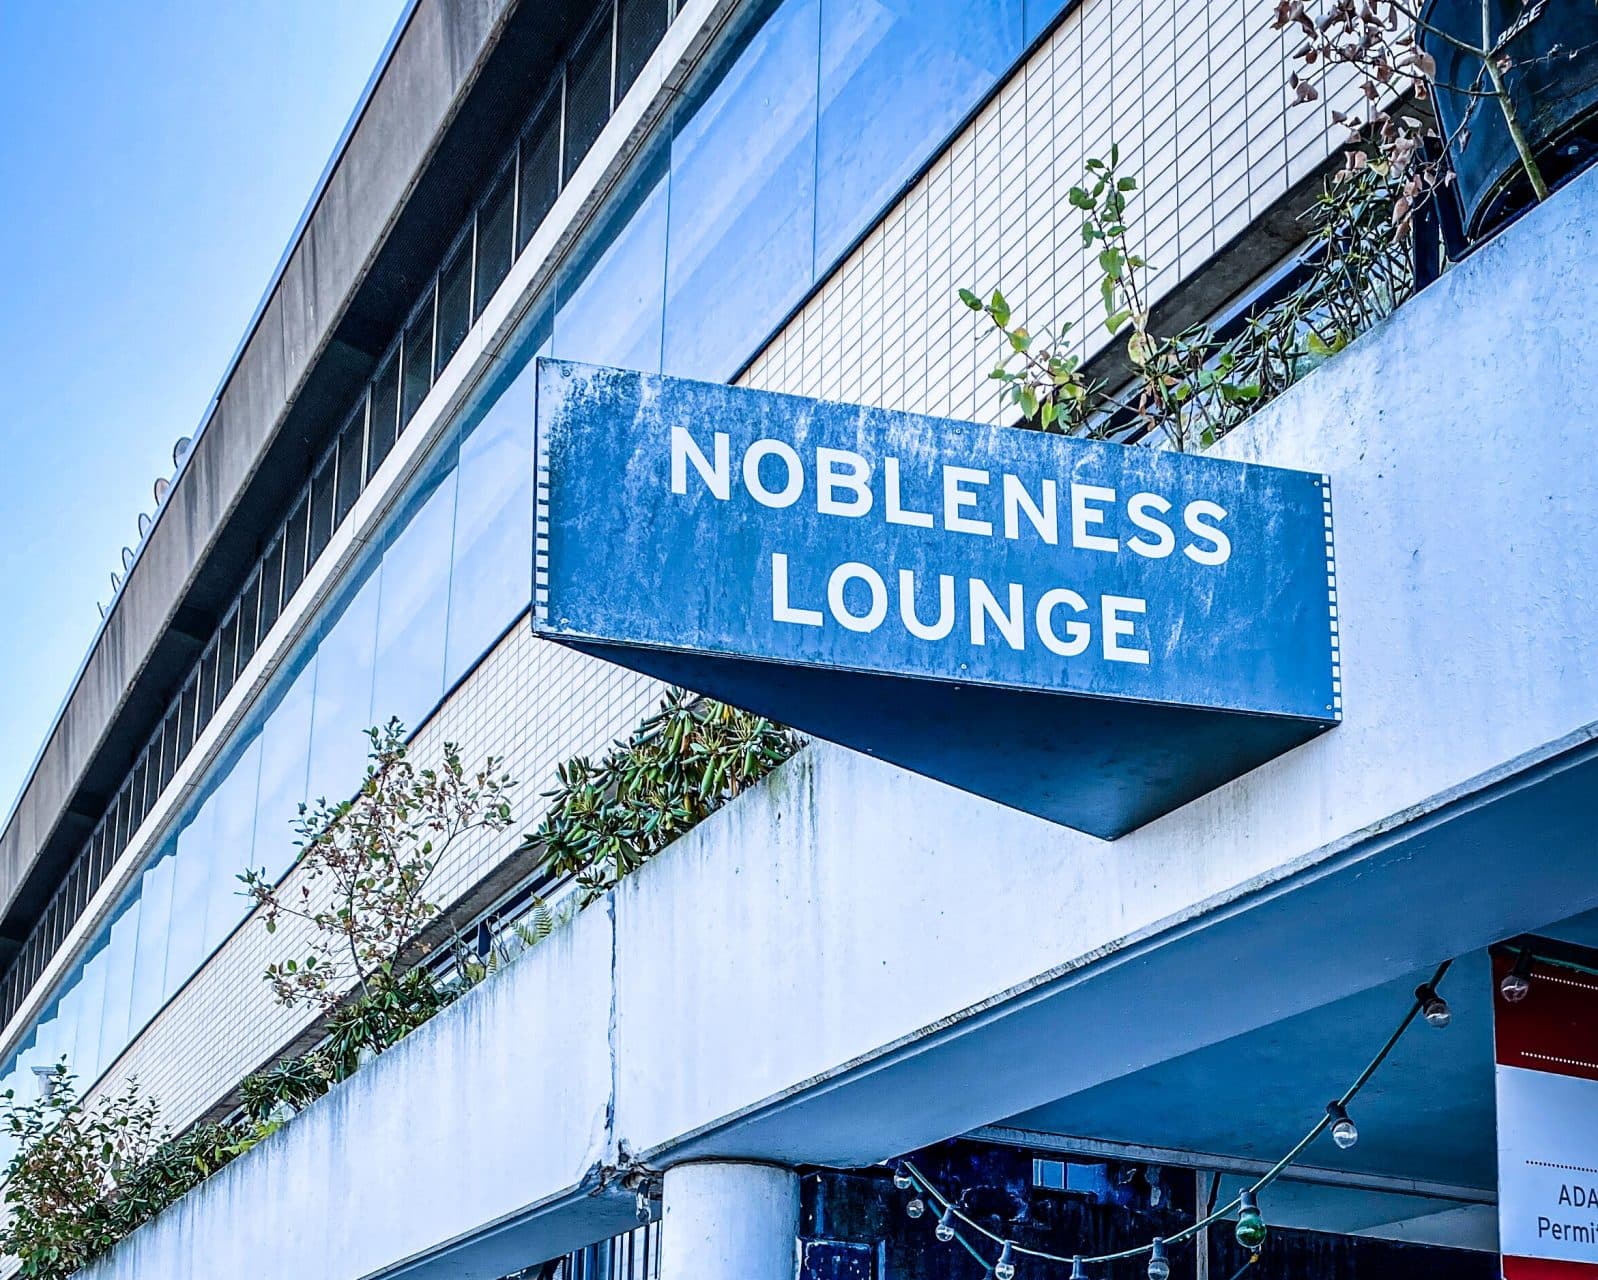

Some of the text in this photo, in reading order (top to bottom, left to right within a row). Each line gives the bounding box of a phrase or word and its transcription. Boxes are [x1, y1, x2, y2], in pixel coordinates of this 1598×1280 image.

[671, 425, 1231, 565] NOBLENESS
[771, 553, 1150, 664] LOUNGE
[1558, 1184, 1598, 1209] ADA
